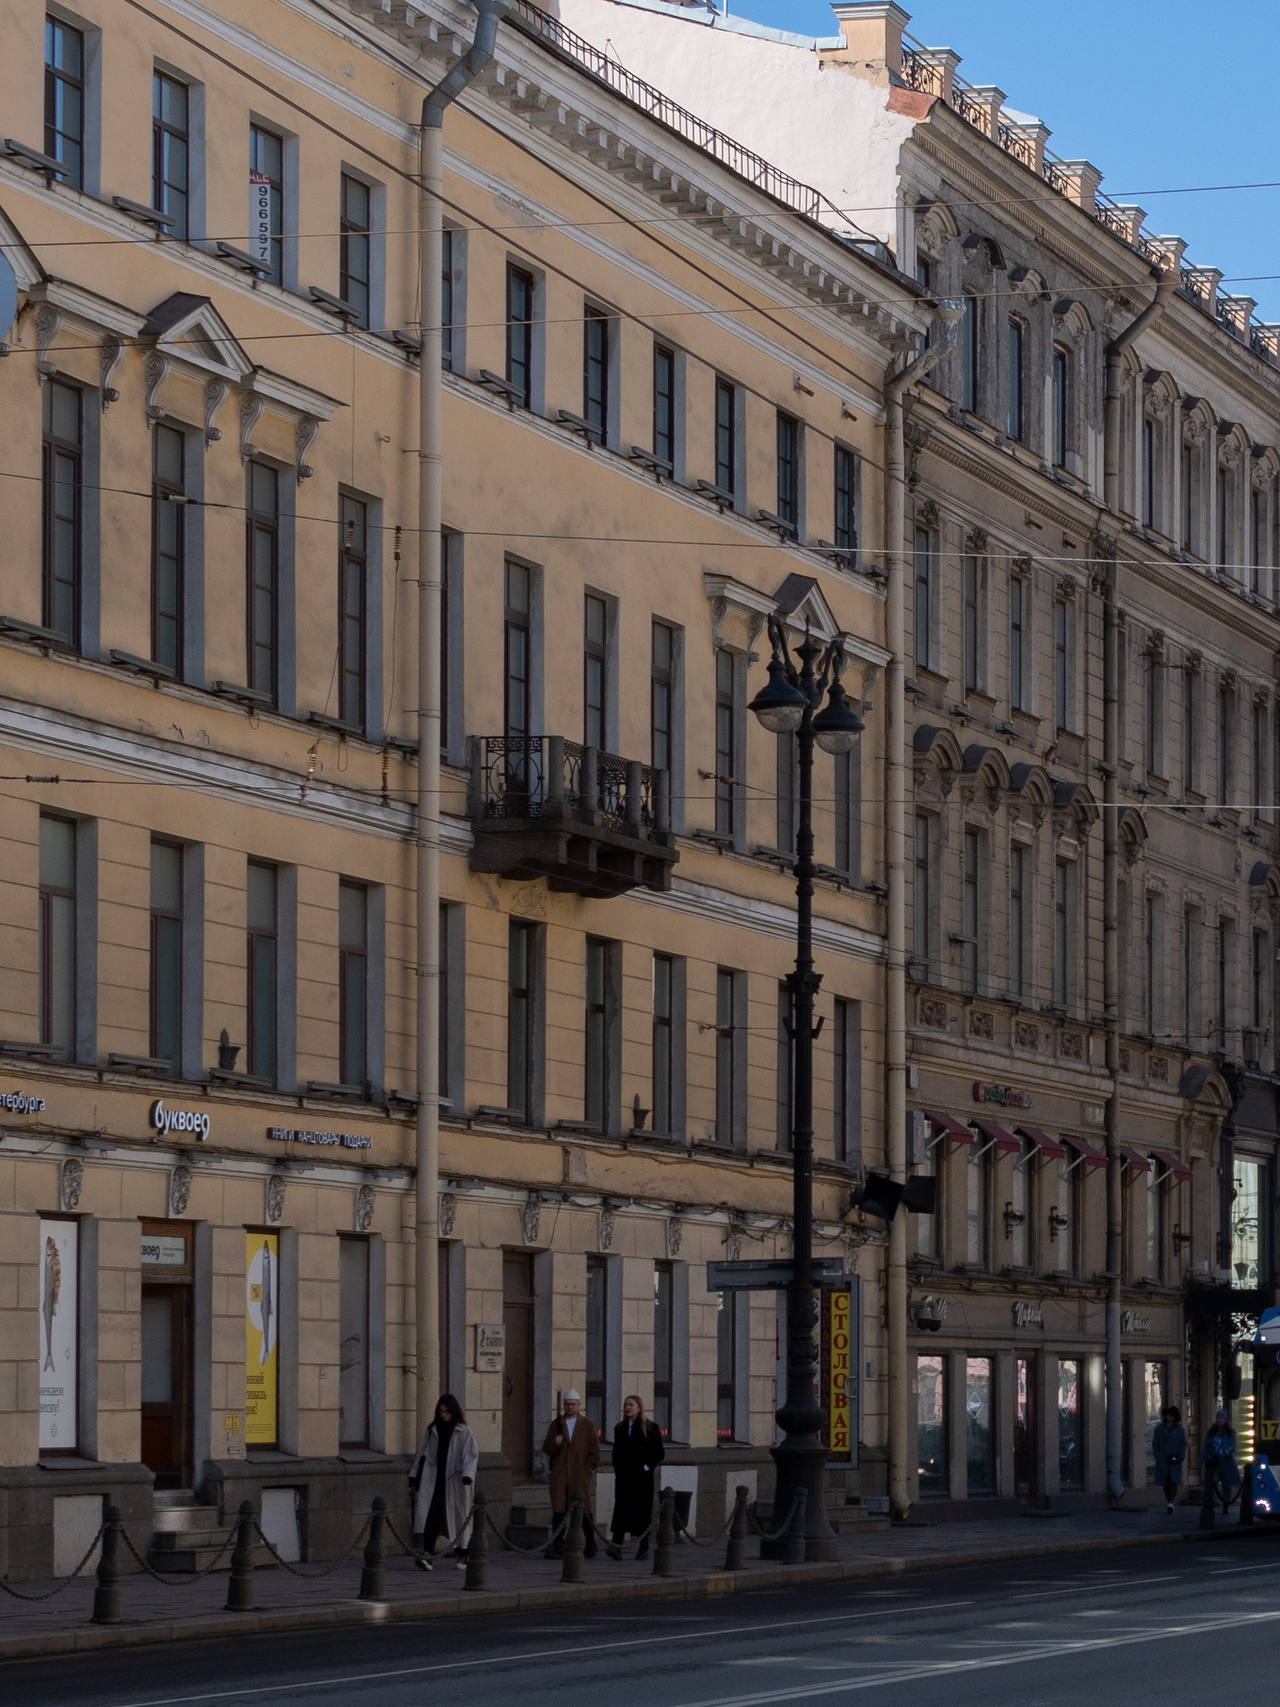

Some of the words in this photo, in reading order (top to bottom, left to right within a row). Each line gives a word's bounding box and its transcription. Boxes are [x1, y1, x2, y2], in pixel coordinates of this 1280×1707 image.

[271, 1128, 295, 1142] КНИГИ
[298, 1130, 341, 1146] КАНЦТОВАРЫ
[345, 1134, 373, 1149] ПОДАРКИ
[832, 1294, 849, 1448] СТОЛОВАЯ
[1262, 1422, 1280, 1438] 17
